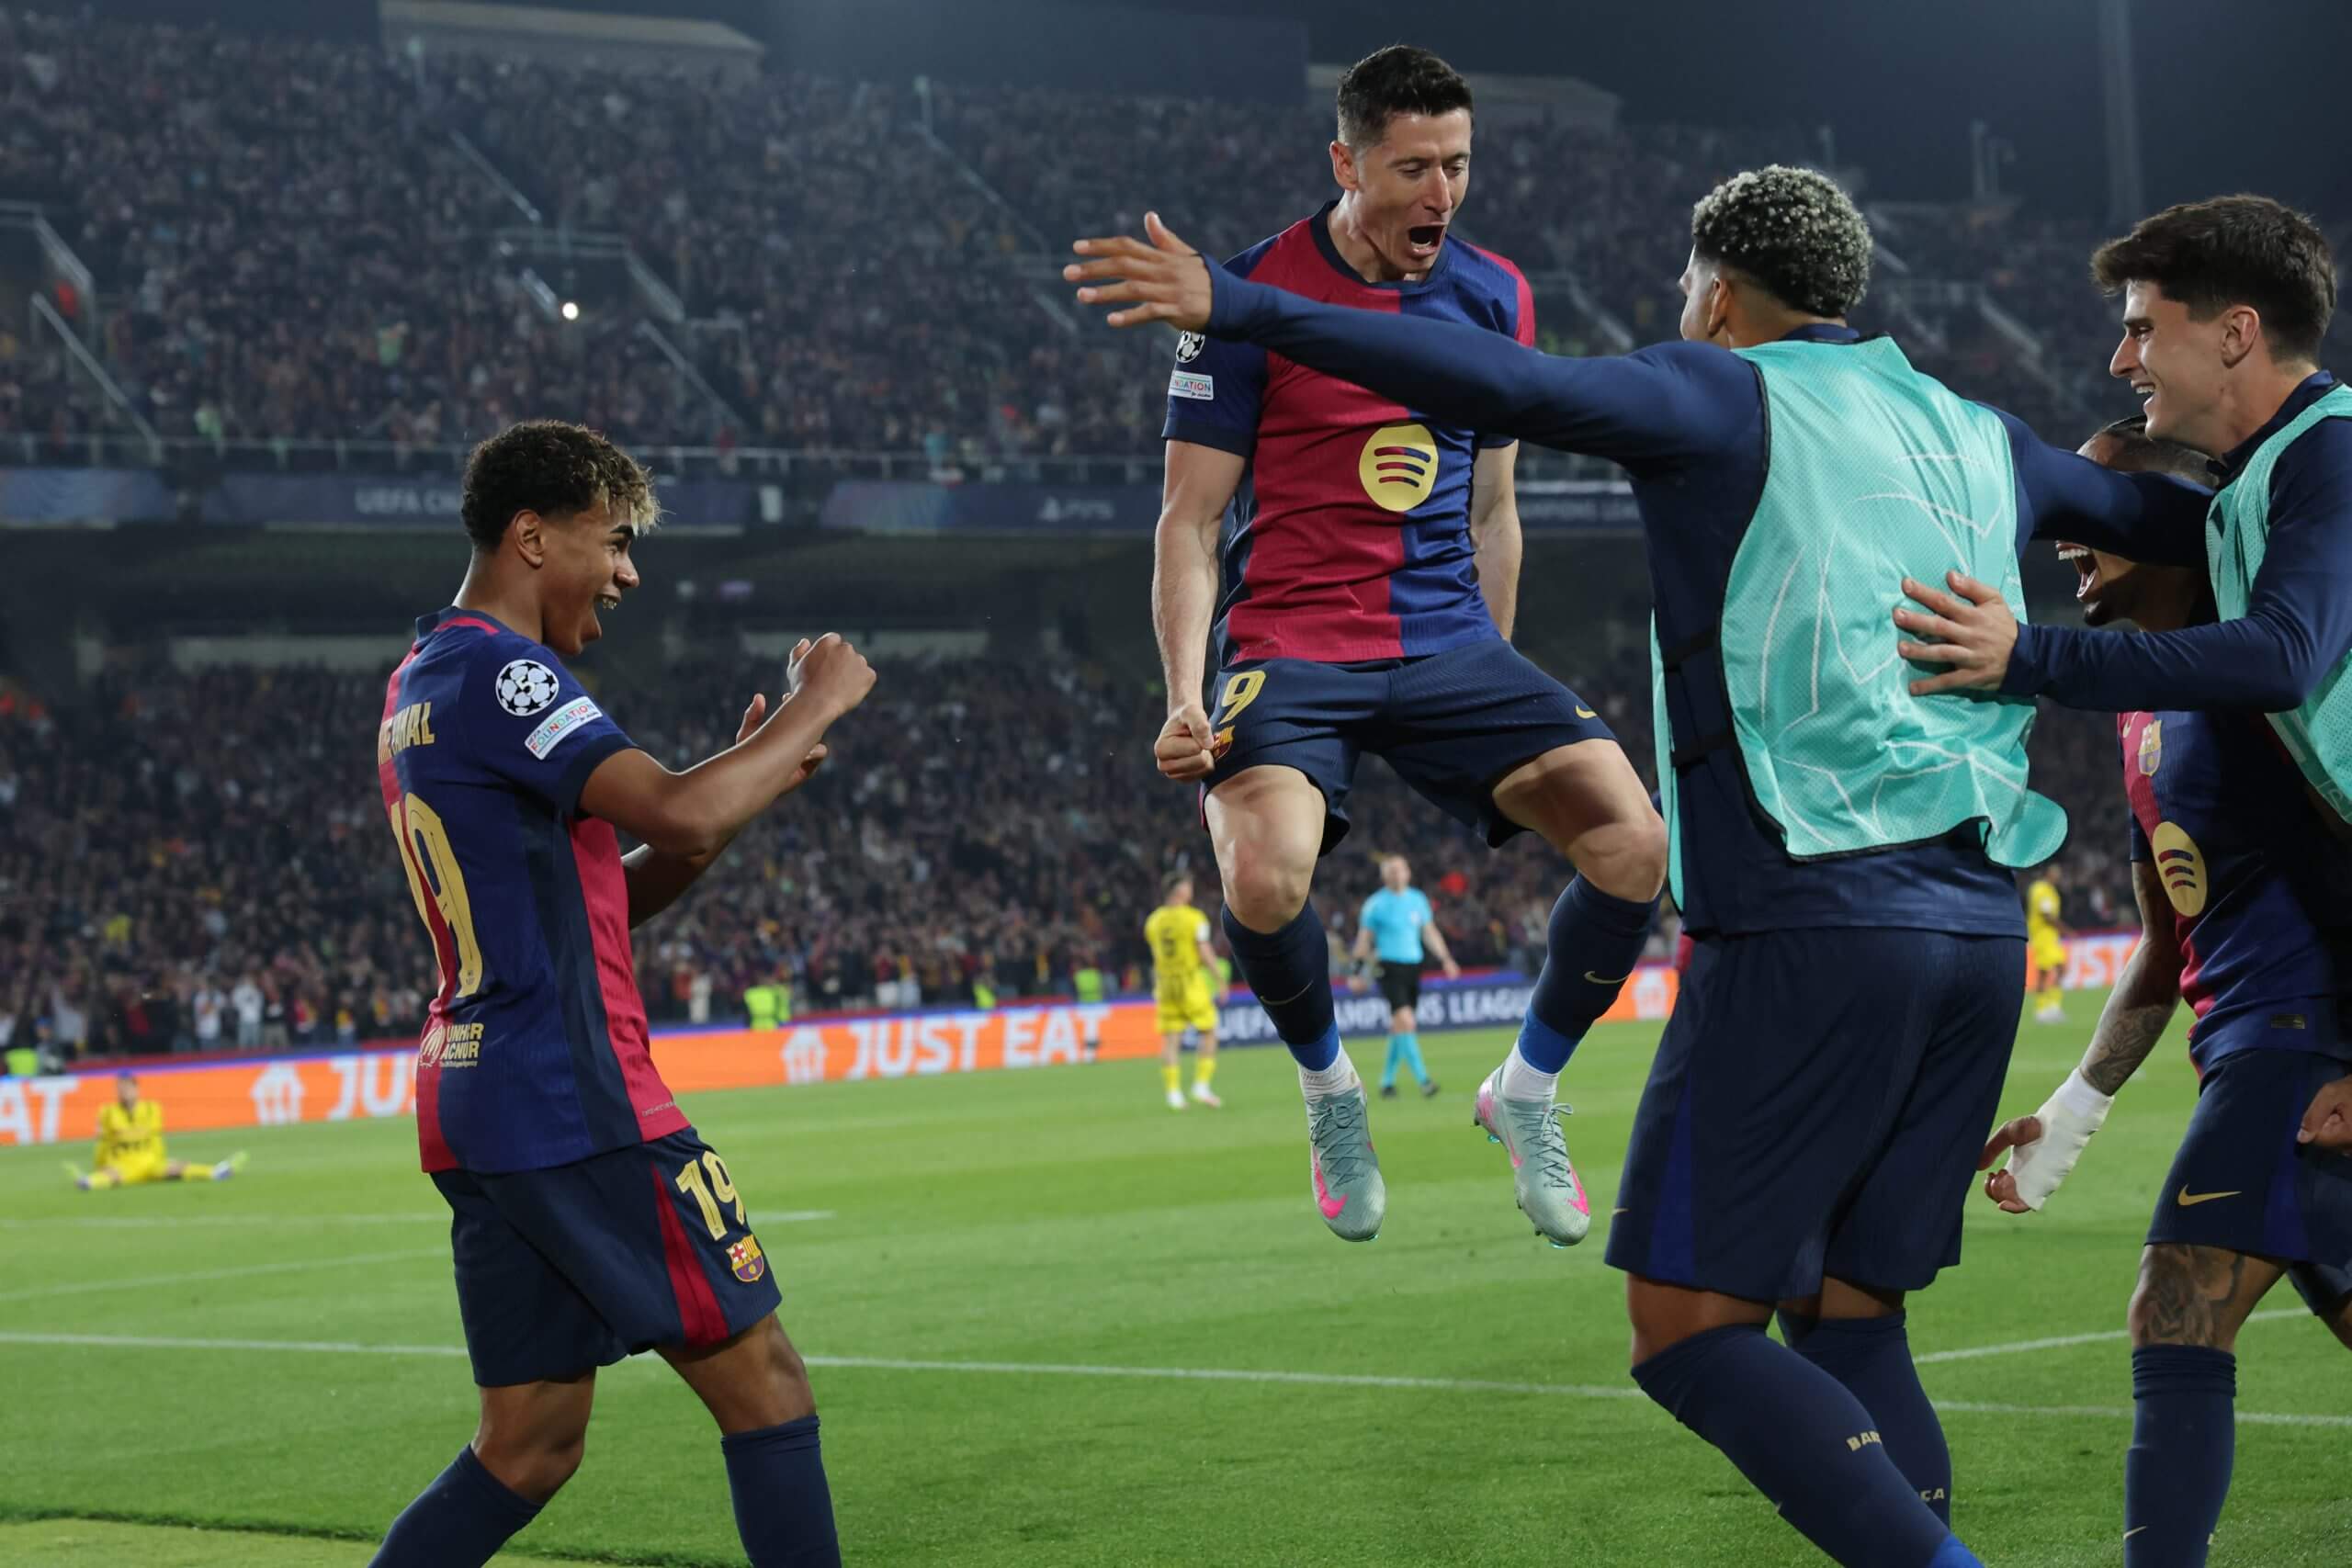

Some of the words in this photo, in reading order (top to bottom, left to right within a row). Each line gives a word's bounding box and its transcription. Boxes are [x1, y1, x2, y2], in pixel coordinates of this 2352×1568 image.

[1221, 670, 1266, 725] 9
[390, 792, 482, 998] 19
[846, 1012, 990, 1081] JUST
[1003, 1005, 1112, 1068] EAT
[328, 1053, 420, 1121] JU
[675, 1150, 745, 1241] 19
[1846, 1430, 1883, 1452] BAR
